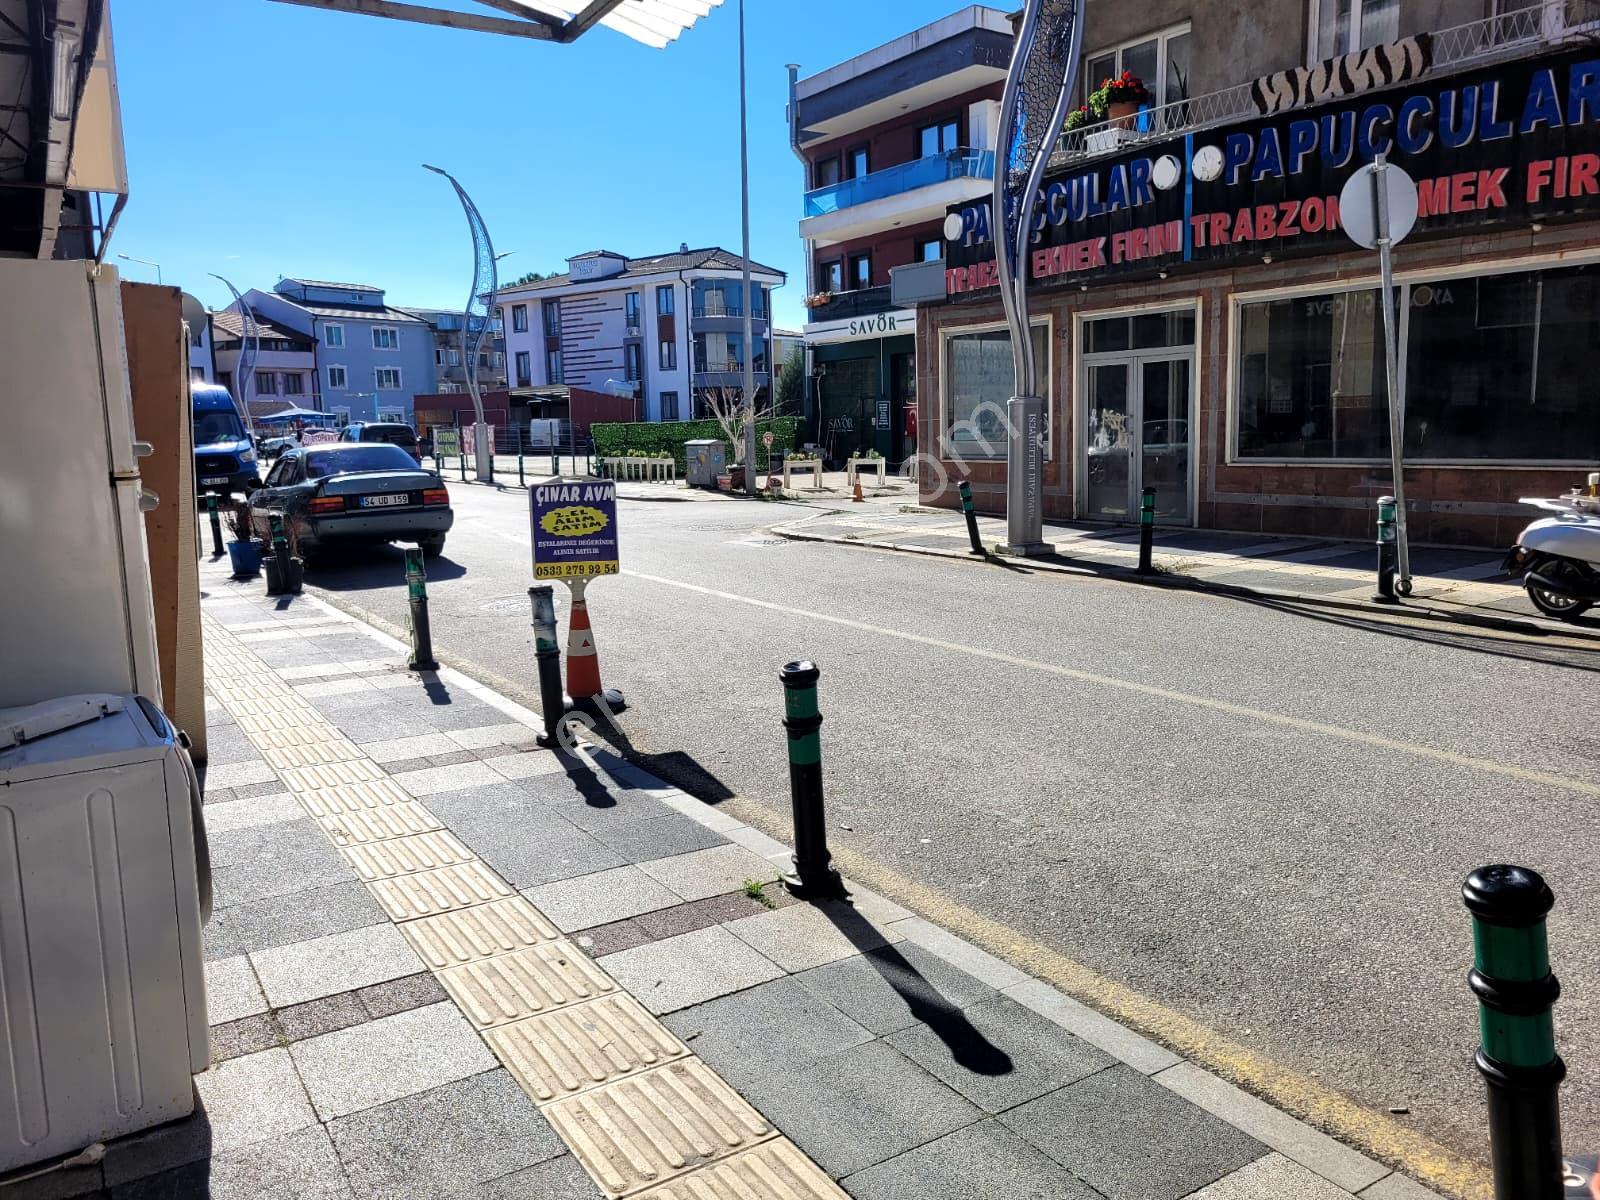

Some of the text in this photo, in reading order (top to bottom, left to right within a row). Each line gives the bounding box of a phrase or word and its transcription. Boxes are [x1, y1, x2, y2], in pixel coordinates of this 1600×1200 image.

[1416, 166, 1511, 220] MEK
[1032, 236, 1107, 279] EKMEK
[1111, 219, 1184, 265] FIRINI
[364, 496, 375, 506] 54
[393, 495, 408, 504] 159
[536, 485, 616, 507] ÇINAR AVM
[553, 521, 602, 532] SATIM
[555, 515, 595, 525] ALIM
[536, 563, 617, 577] 0533 279 92 54
